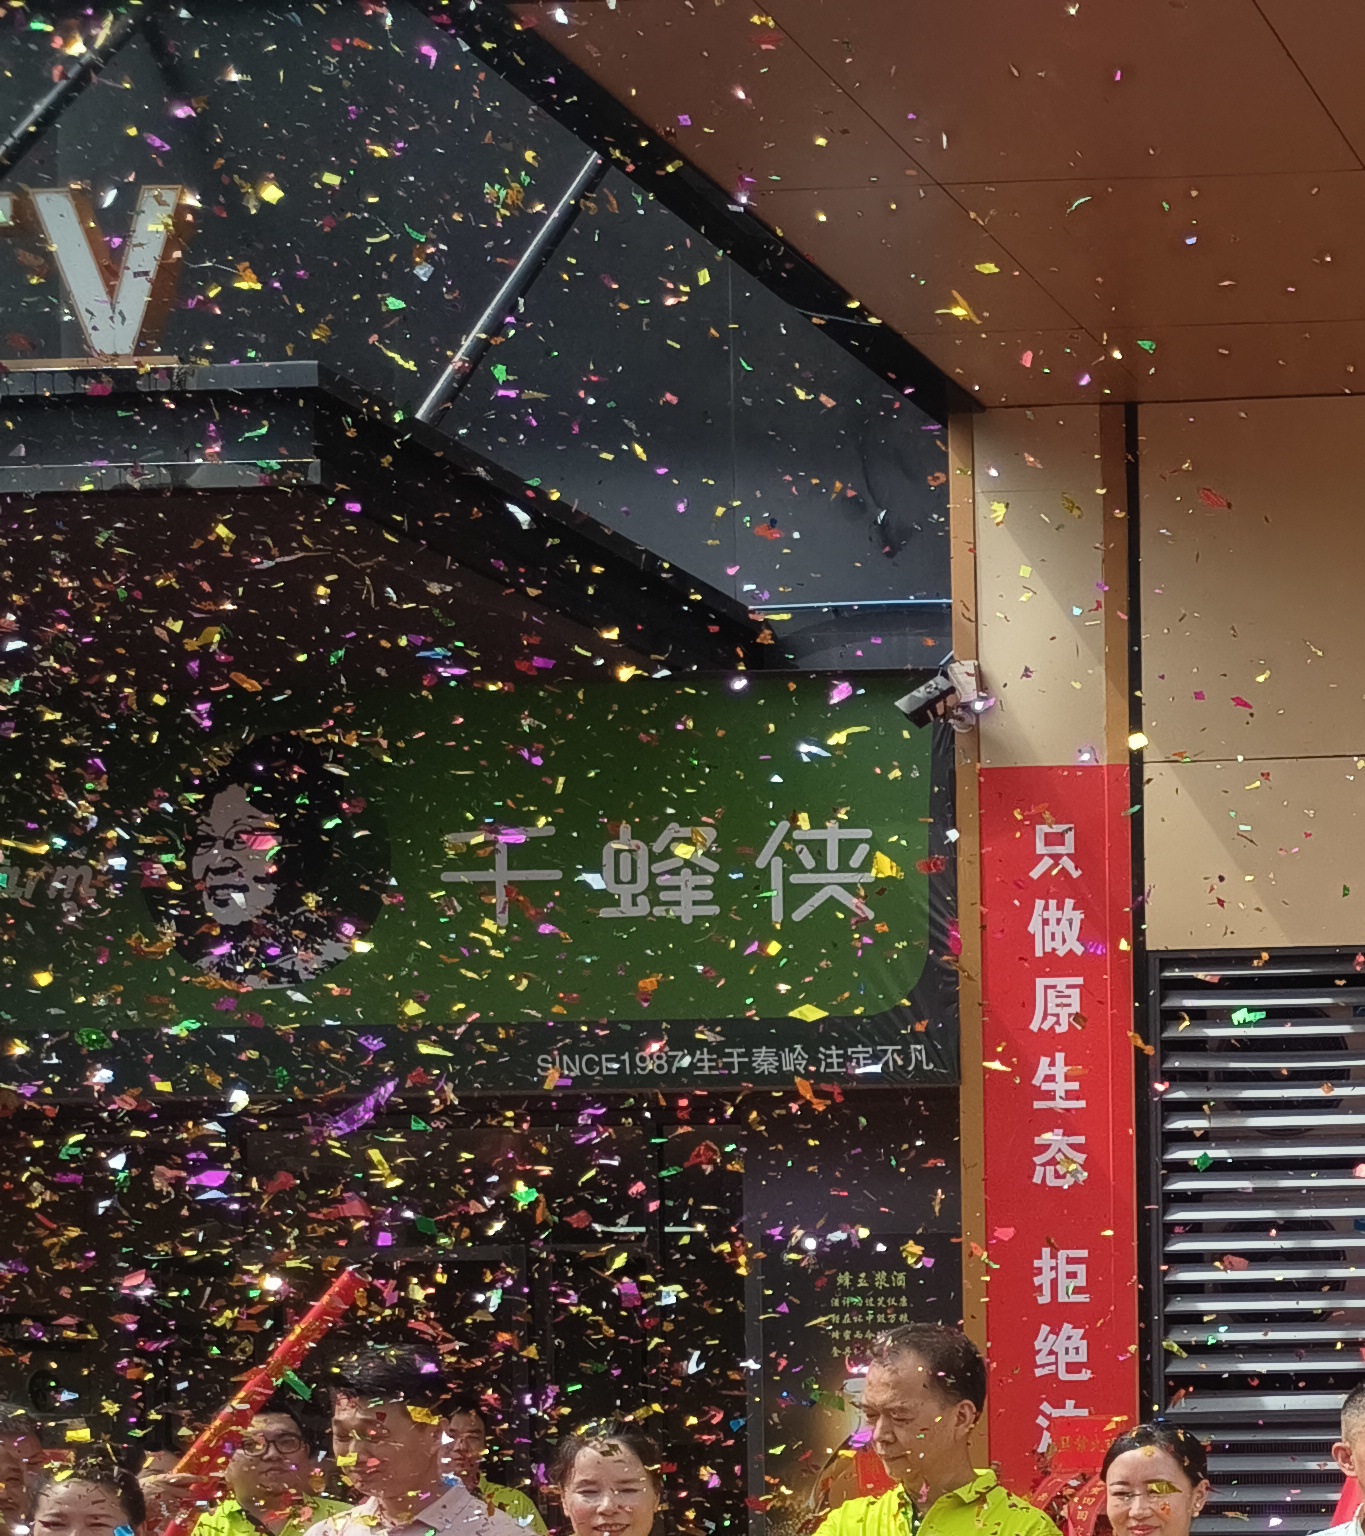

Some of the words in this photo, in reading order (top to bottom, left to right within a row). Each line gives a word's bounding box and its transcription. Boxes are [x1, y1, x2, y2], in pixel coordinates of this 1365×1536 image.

[0, 184, 187, 357] V
[440, 819, 877, 926] 千蜂侠
[536, 1050, 681, 1077] SINCE1987
[692, 1046, 809, 1076] 生于秦岭
[1027, 823, 1088, 1188] 只做原生态
